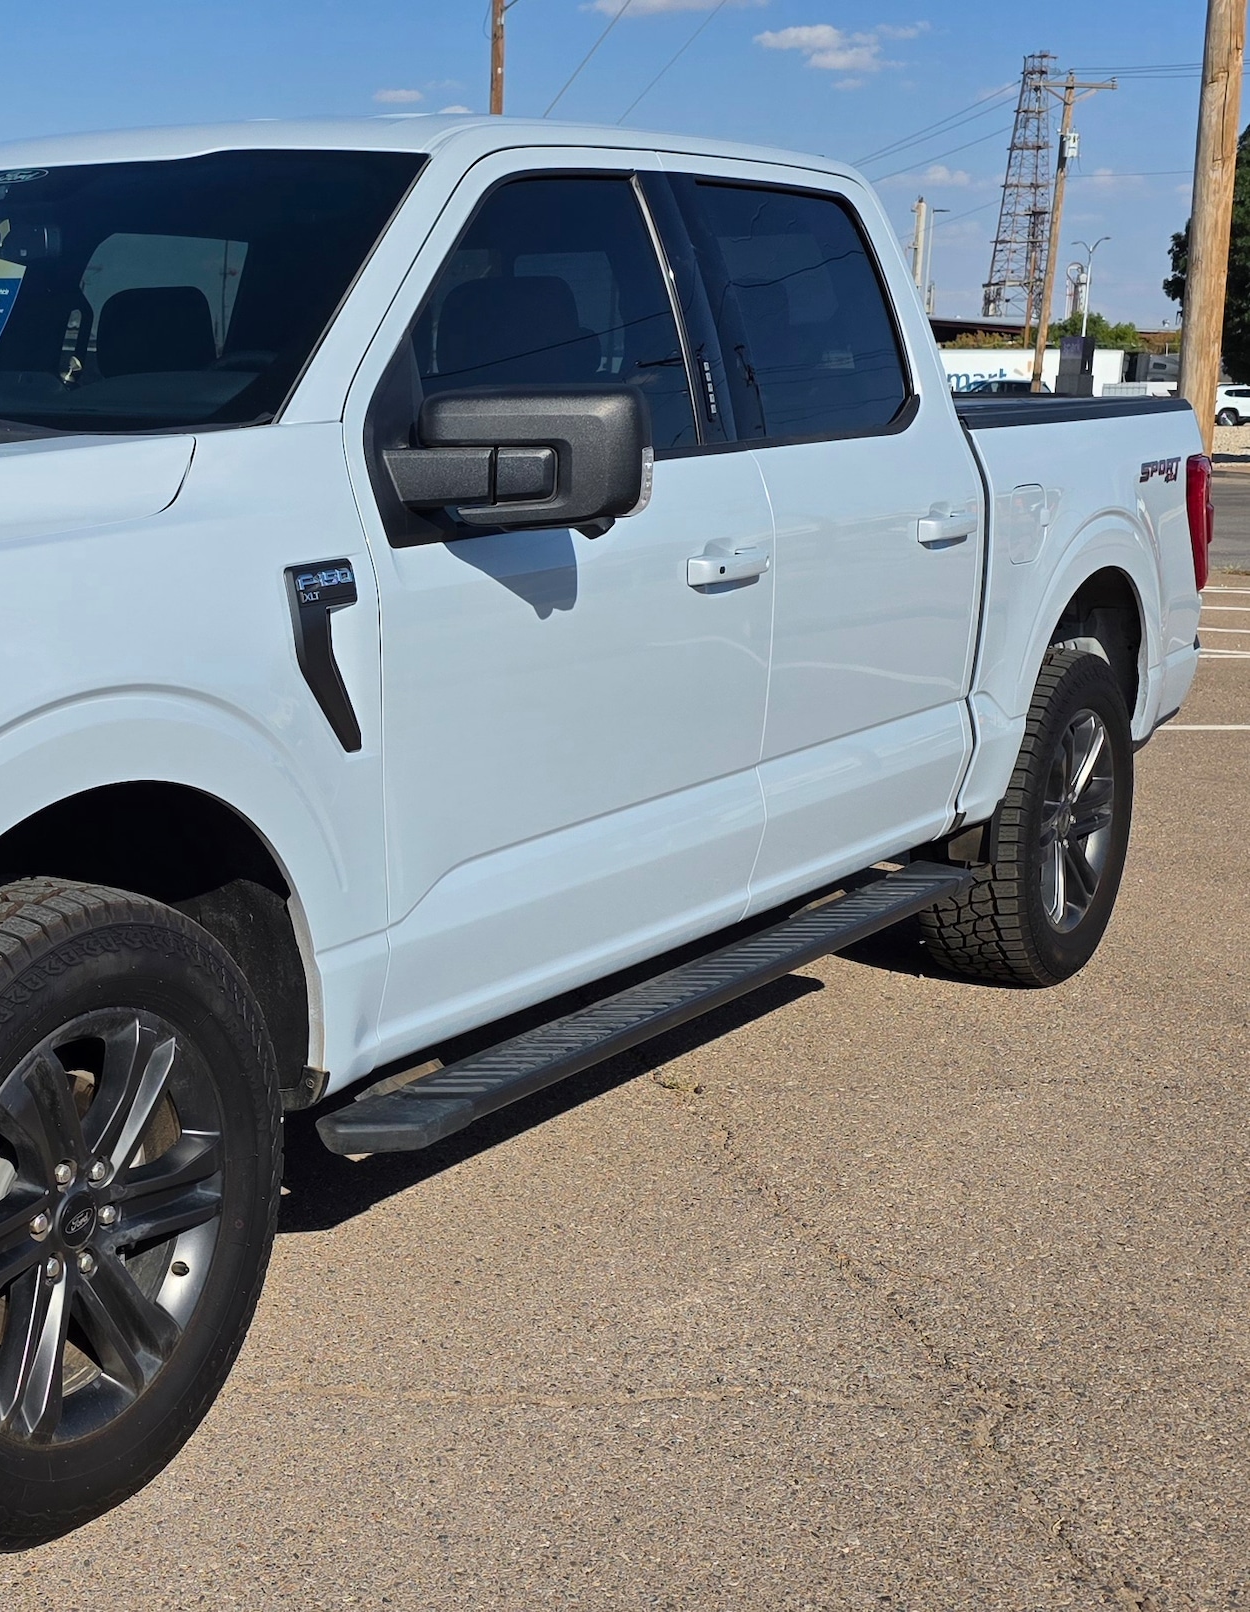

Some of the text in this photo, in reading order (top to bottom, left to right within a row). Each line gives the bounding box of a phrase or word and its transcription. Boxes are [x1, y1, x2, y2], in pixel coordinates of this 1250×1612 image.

[1139, 456, 1181, 483] SPORT
[295, 567, 354, 591] F-150
[302, 591, 320, 603] XLT
[70, 1211, 89, 1232] Ford
